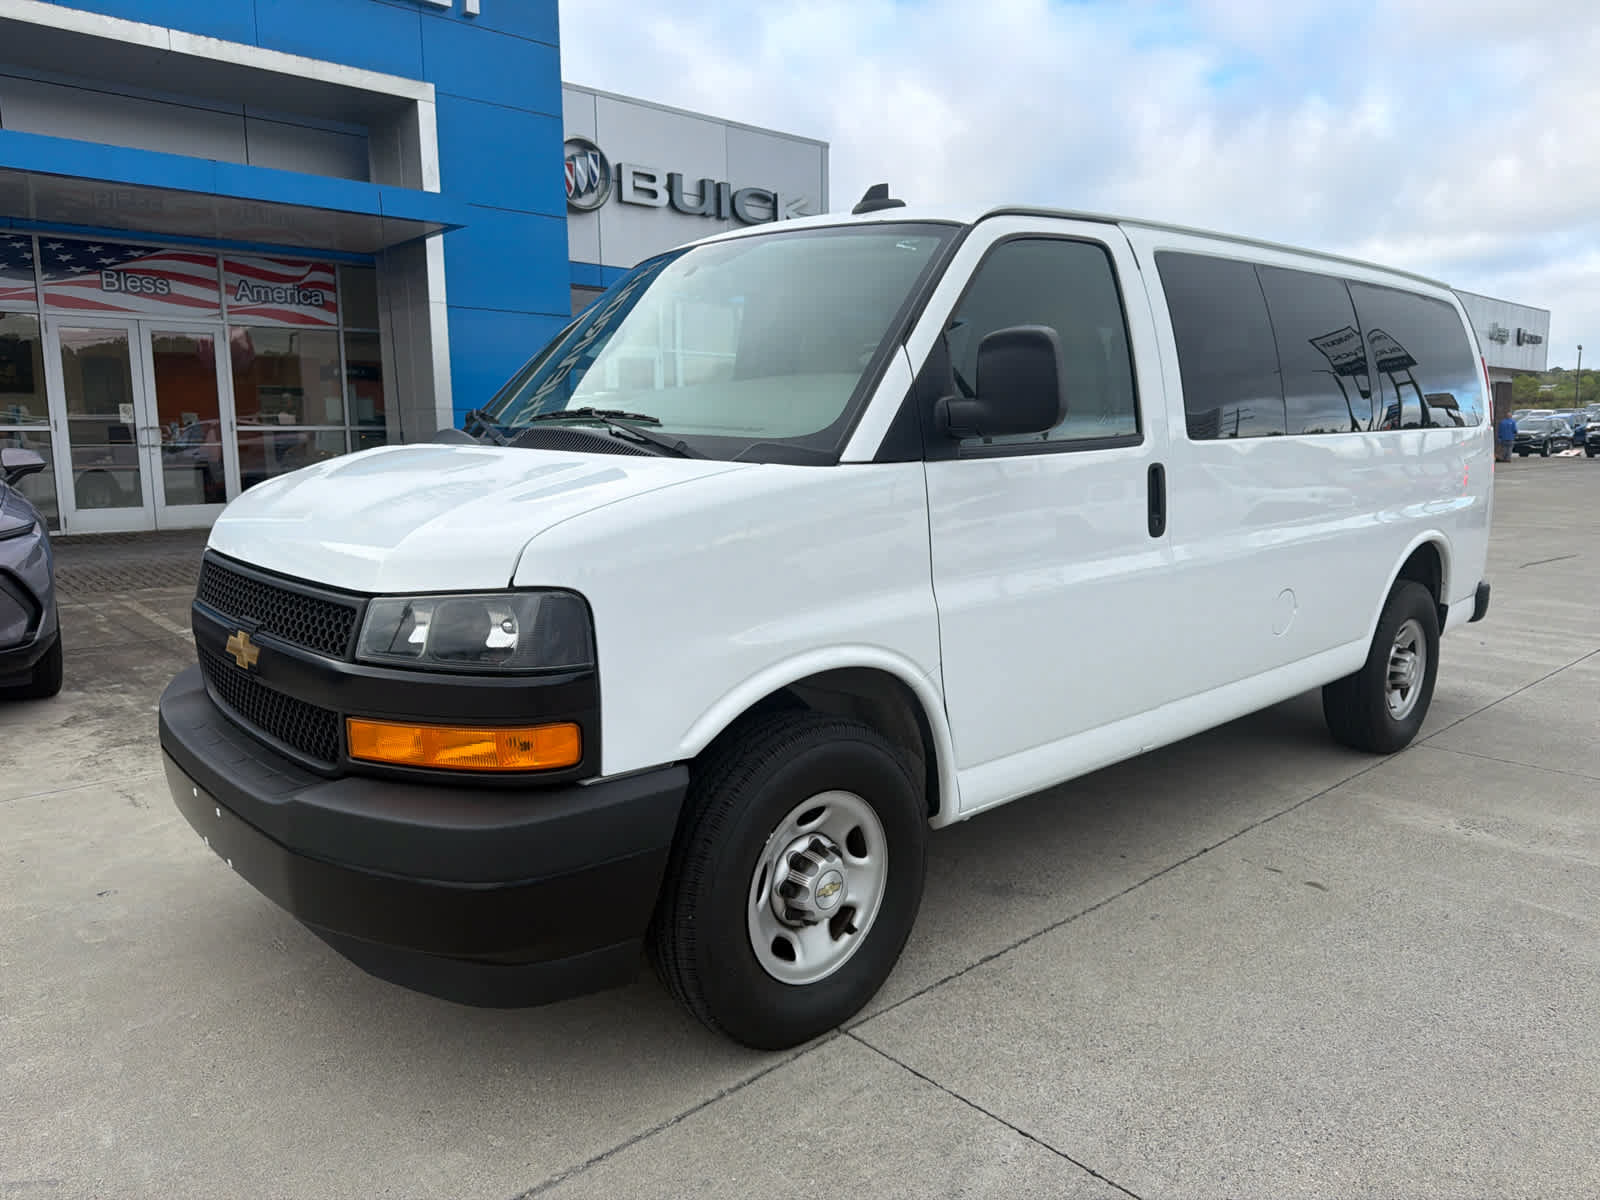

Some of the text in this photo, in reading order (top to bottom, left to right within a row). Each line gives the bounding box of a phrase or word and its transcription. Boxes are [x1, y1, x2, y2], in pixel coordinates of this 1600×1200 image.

[615, 162, 811, 225] BUICK
[101, 270, 325, 305] Bless America
